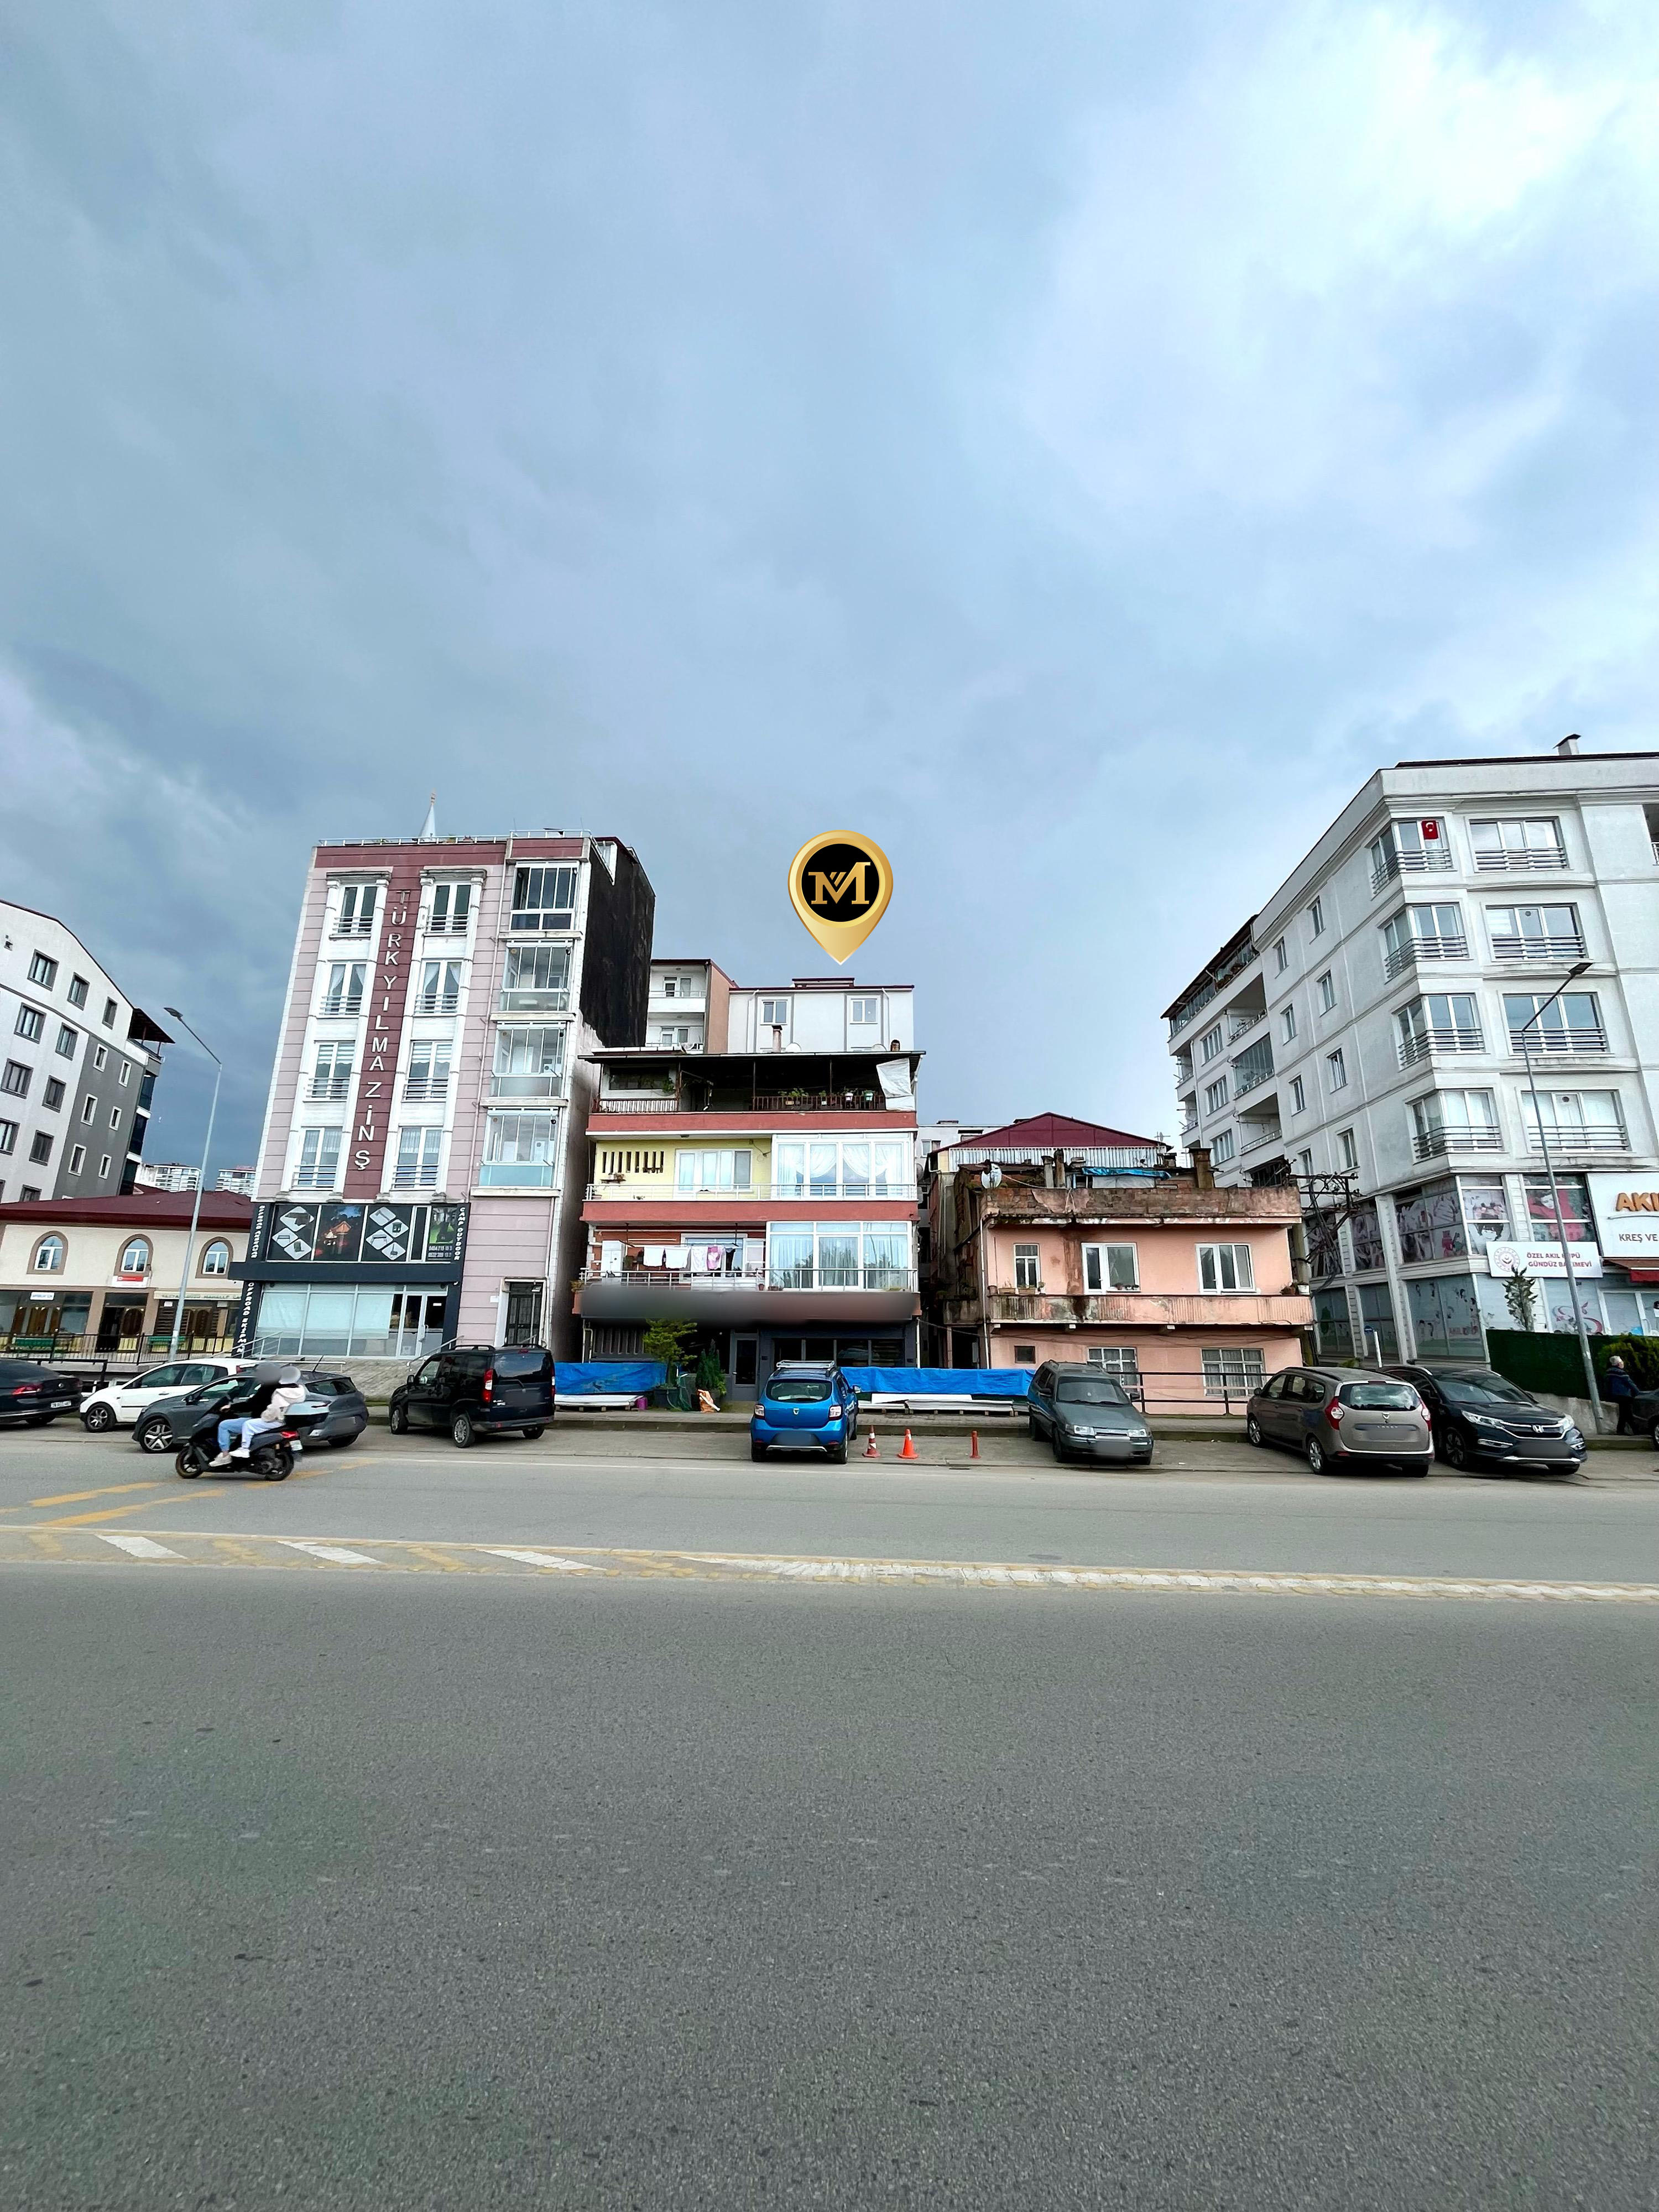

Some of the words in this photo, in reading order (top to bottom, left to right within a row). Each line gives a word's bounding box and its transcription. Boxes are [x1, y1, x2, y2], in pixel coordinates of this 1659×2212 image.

[457, 1207, 466, 1226] CAMP
[453, 1227, 463, 1261] OUTDOOR
[1619, 1234, 1643, 1243] KREŞ
[242, 1282, 254, 1316] OFFROAD
